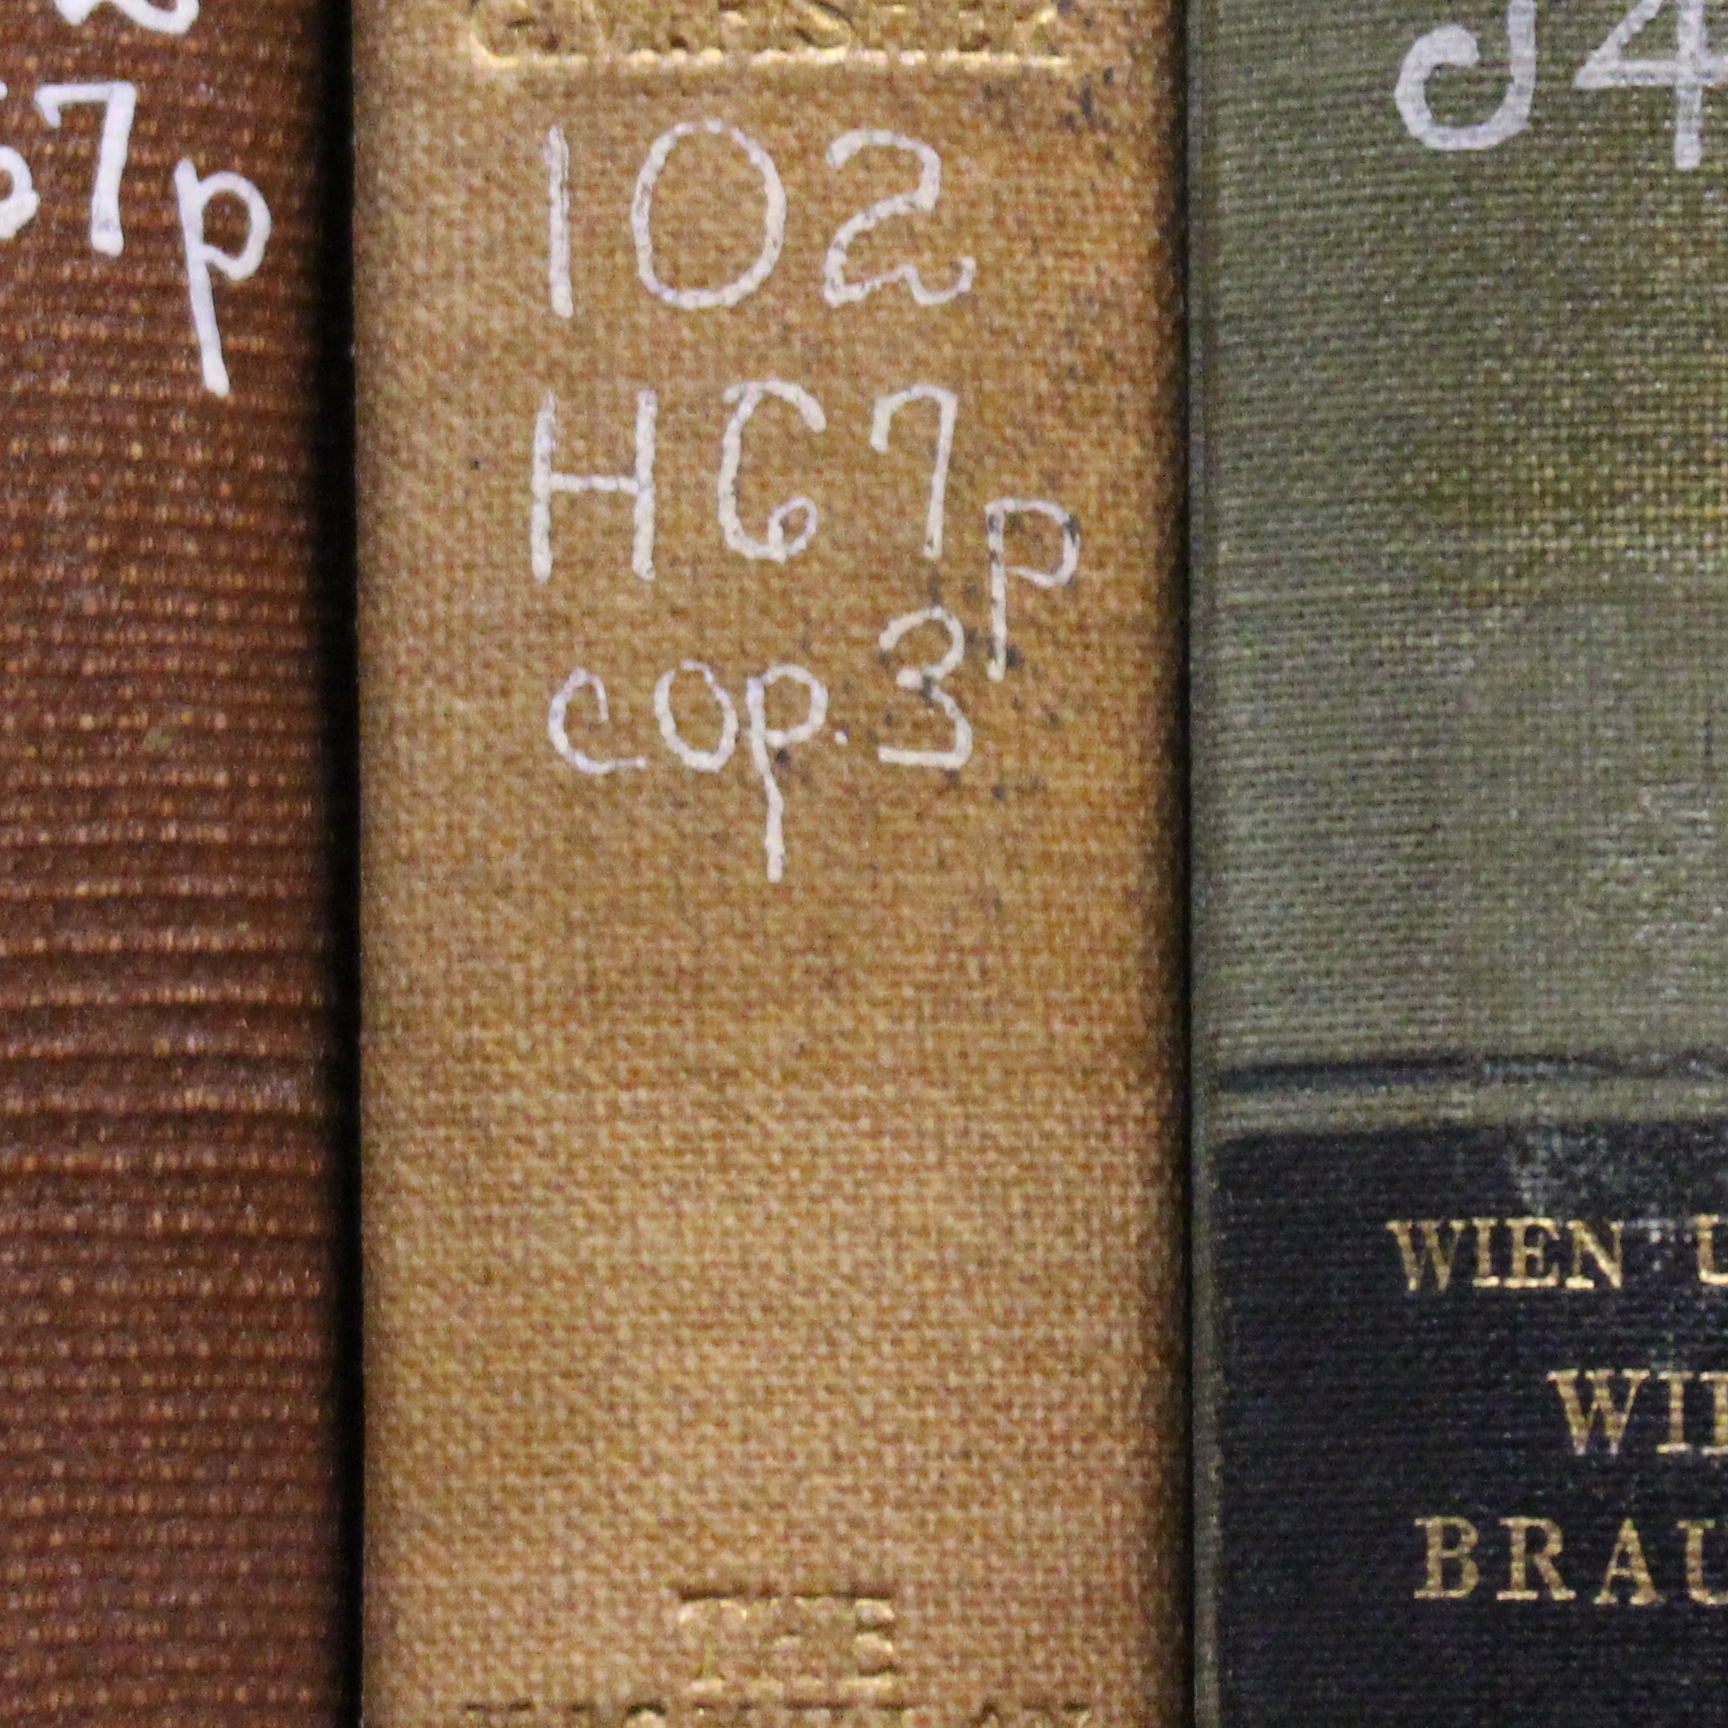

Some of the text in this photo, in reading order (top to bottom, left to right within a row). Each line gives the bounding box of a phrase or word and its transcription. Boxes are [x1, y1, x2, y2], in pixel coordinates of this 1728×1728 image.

[544, 120, 976, 318] 102
[530, 380, 1080, 680] H67p
[1386, 1214, 1624, 1294] WIEN
